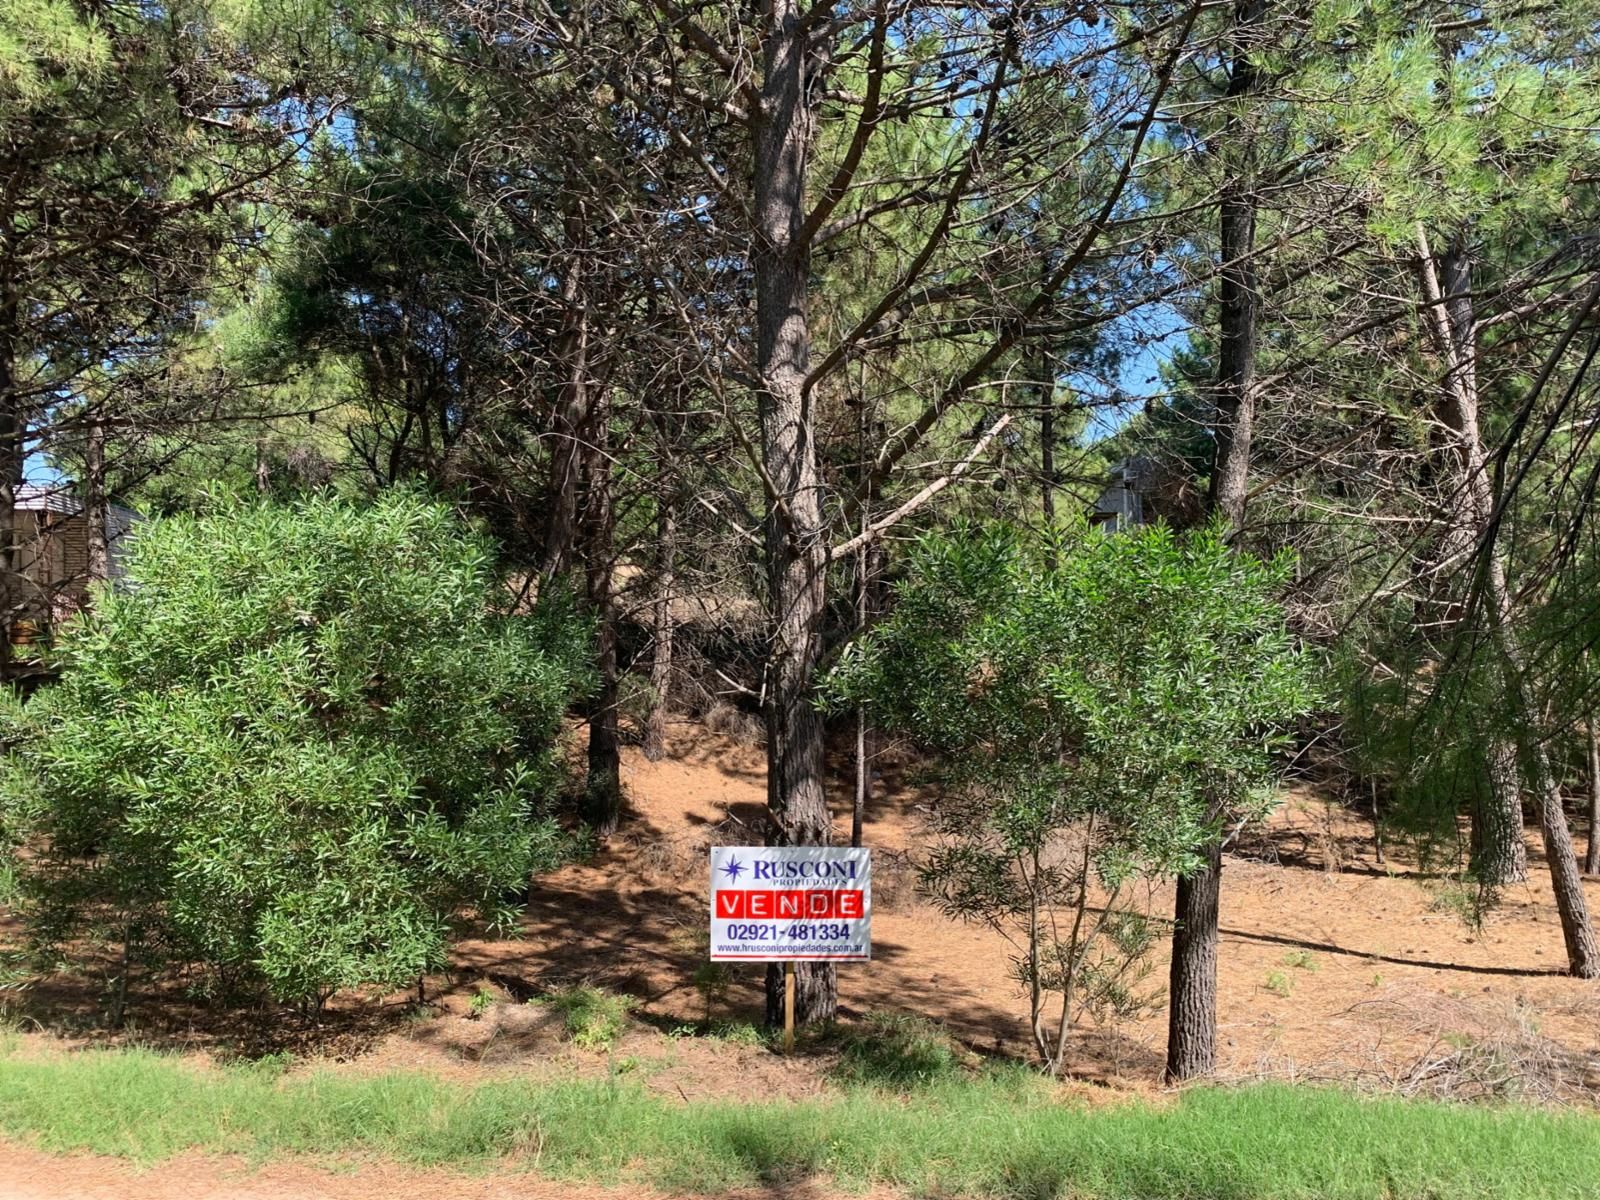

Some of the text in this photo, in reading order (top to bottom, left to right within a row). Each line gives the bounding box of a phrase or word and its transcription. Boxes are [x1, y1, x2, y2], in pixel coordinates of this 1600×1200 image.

[753, 860, 856, 879] RUSCONI
[722, 894, 857, 914] VENDE
[727, 924, 850, 940] 02921-481334
[717, 943, 863, 953] www.hrusconipropiedades.com.ar
